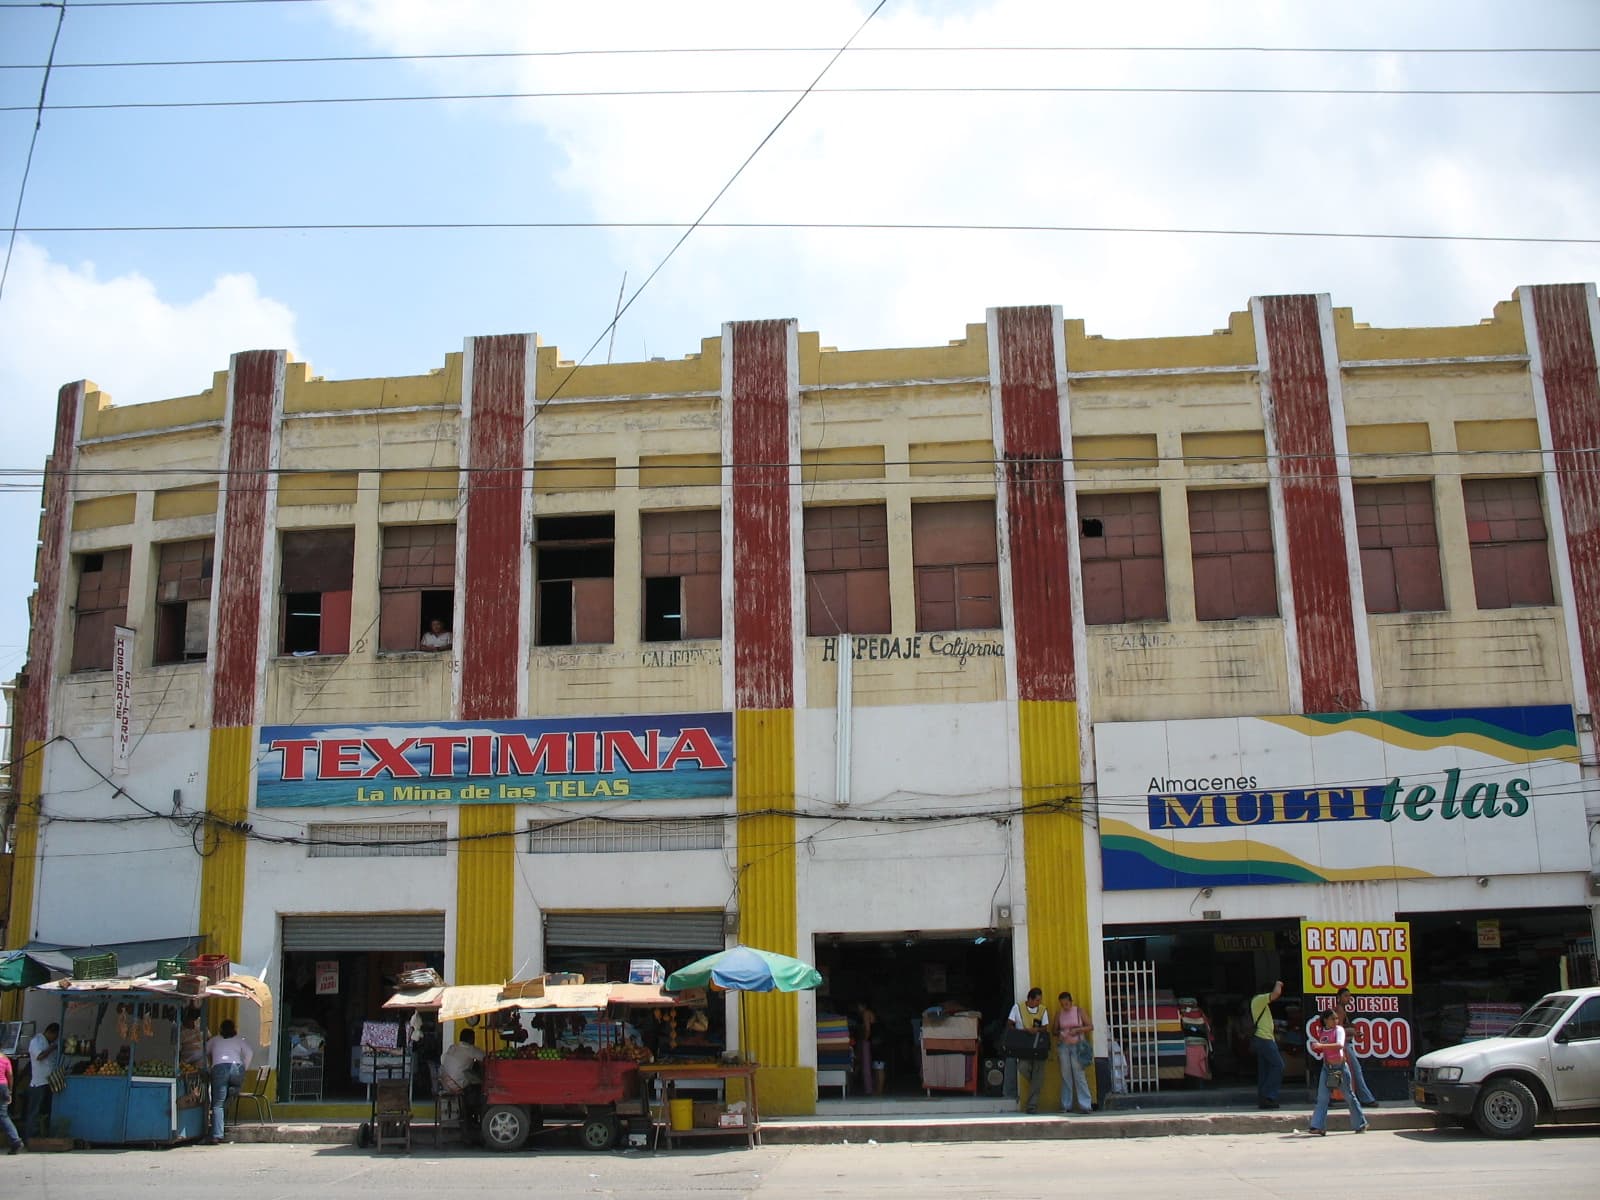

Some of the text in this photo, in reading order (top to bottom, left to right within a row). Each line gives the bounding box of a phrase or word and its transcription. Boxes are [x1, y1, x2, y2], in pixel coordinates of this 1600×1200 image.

[822, 634, 1005, 666] HSPEDAJE California
[116, 639, 124, 720] HOSPEDAJE
[270, 727, 728, 781] TEXTIMINA
[357, 778, 631, 802] La Mina de las TELAS
[1148, 775, 1257, 793] Almacenes
[1306, 927, 1407, 952] REMATE
[1308, 955, 1409, 989] TOTAL
[1316, 996, 1399, 1013] TELS DESDE
